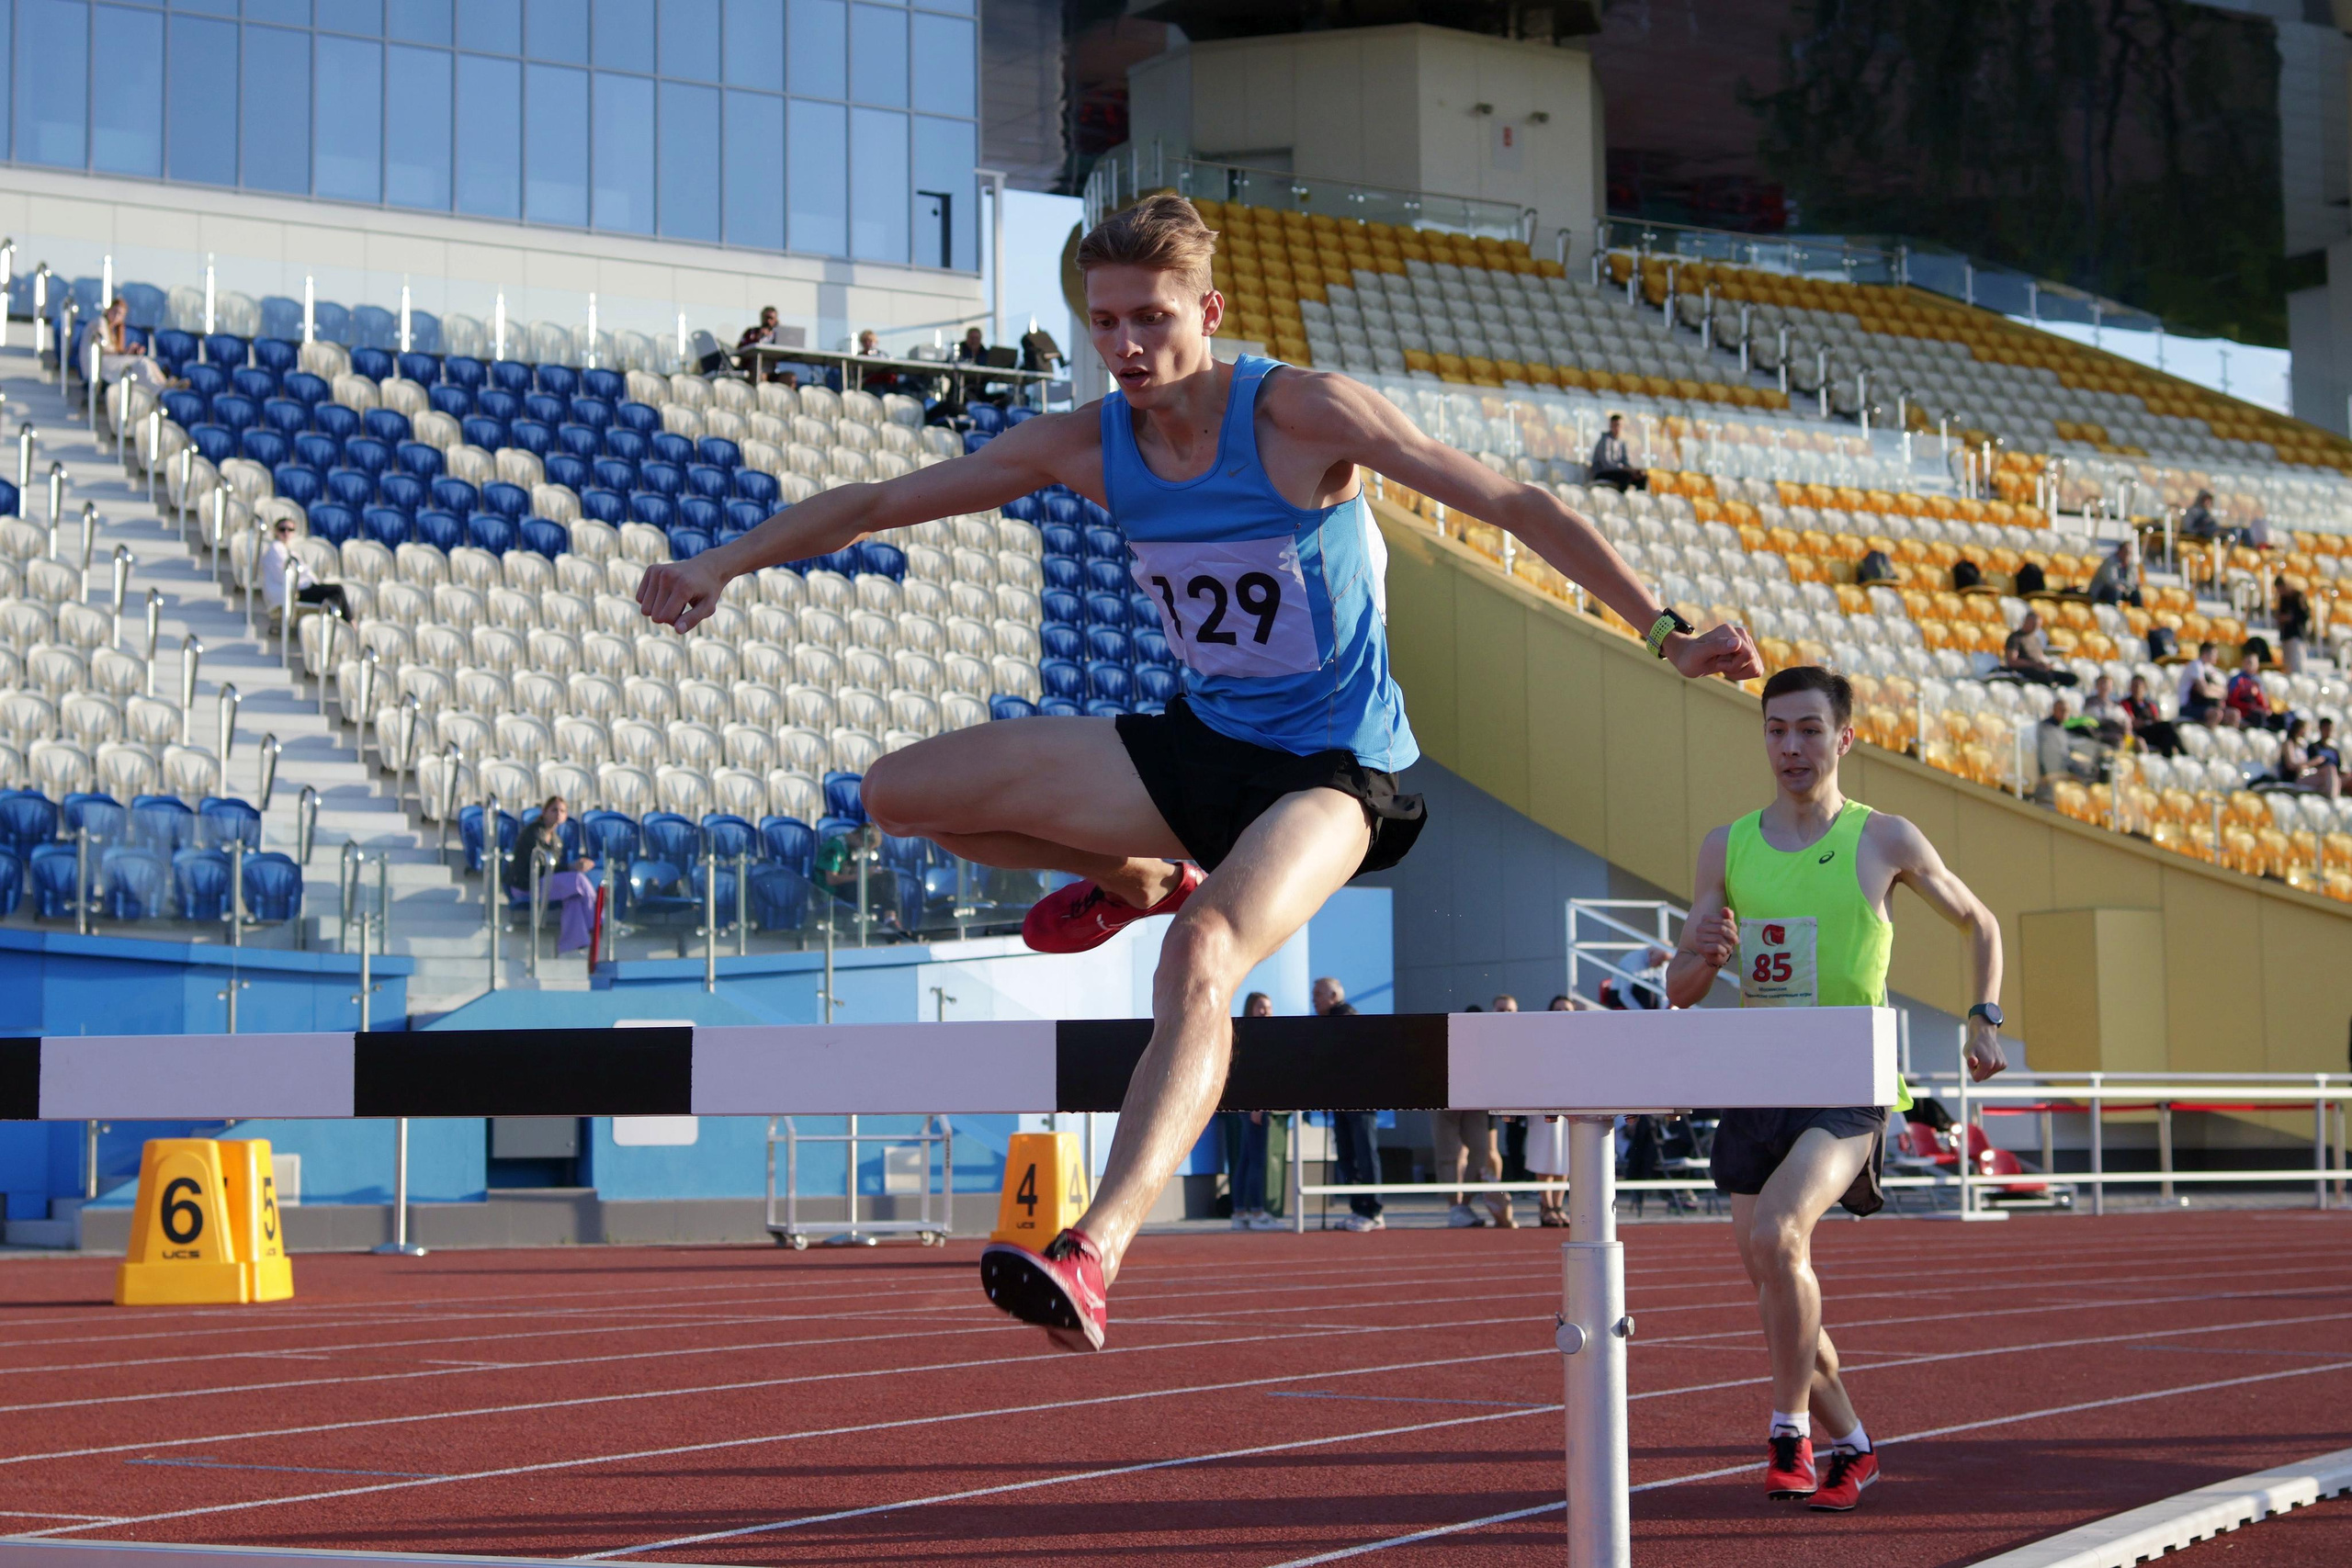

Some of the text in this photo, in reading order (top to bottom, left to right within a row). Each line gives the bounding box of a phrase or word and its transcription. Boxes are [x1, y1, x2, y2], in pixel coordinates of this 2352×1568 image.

[1151, 571, 1282, 646] 129
[1752, 952, 1793, 983] 85
[161, 1177, 203, 1245] 6
[263, 1177, 277, 1241] 5
[1016, 1163, 1038, 1217] 4
[1069, 1163, 1083, 1215] 4
[162, 1249, 201, 1259] UCS
